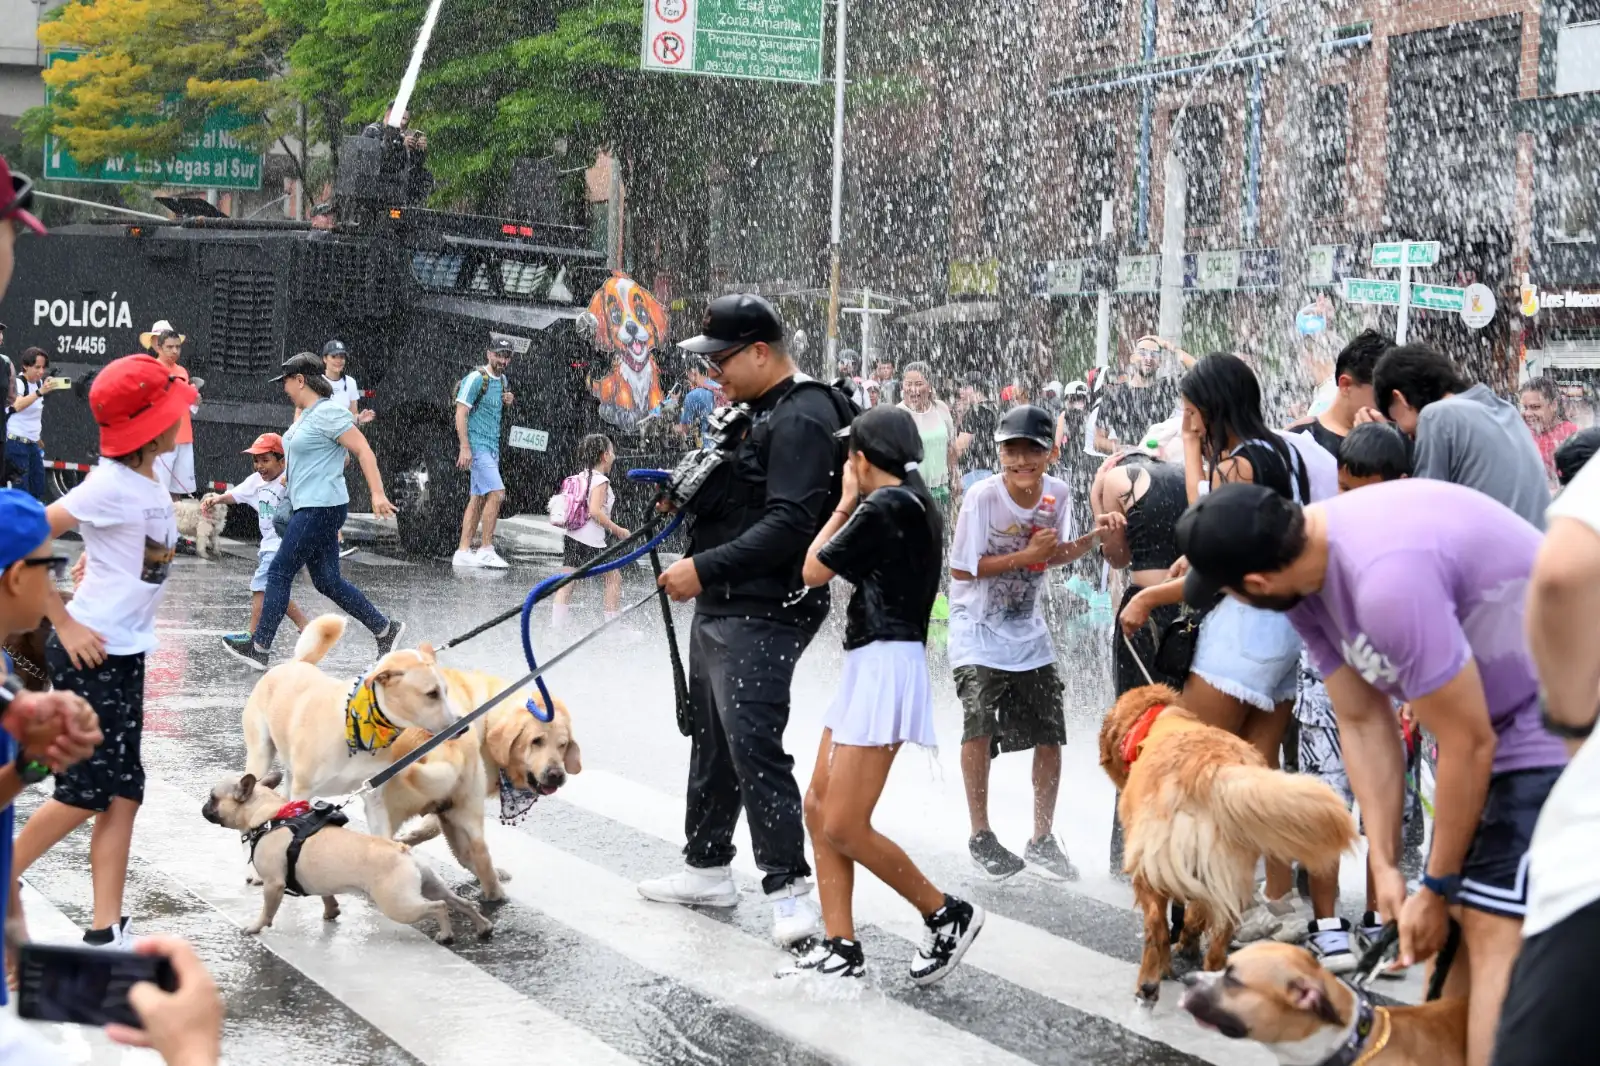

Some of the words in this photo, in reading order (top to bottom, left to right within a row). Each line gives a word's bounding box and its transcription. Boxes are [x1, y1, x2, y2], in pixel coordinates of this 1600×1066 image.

[663, 7, 679, 16] Ton
[717, 13, 749, 26] Zona
[753, 16, 802, 31] Amarilla
[708, 33, 758, 47] Prohibido
[716, 49, 748, 60] Lunes
[750, 53, 757, 61] a
[736, 65, 744, 74] a
[202, 130, 216, 147] al
[166, 154, 211, 181] Vegas
[214, 156, 227, 177] al
[231, 158, 256, 179] Sur
[34, 291, 133, 328] POLICÍA
[57, 335, 106, 355] 37-4456
[512, 430, 546, 447] 37-4456
